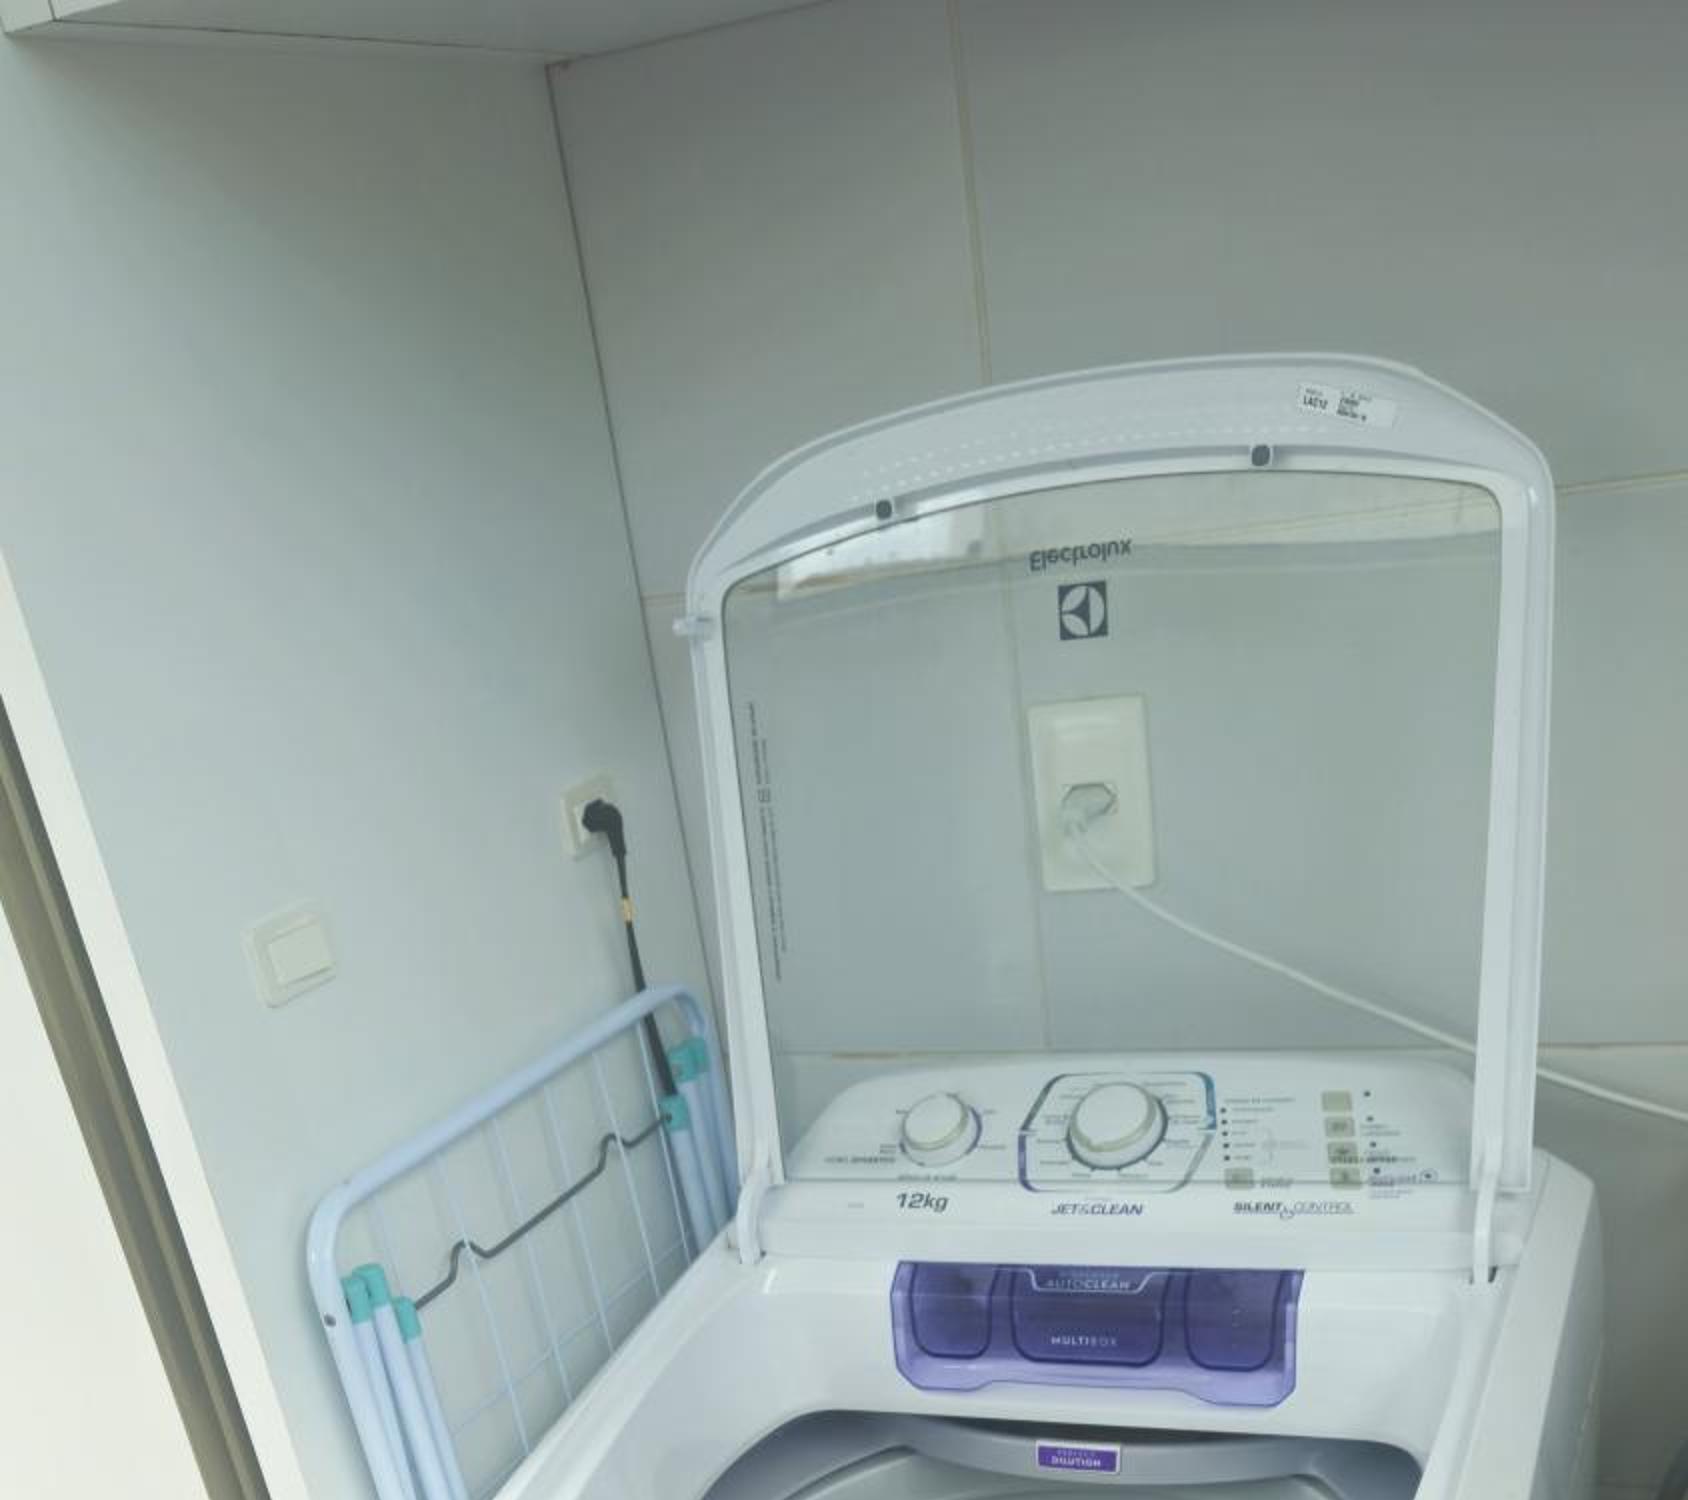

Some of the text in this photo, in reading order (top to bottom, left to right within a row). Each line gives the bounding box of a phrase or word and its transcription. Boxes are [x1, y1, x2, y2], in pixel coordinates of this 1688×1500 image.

[896, 1192, 949, 1213] 12kg
[1234, 1202, 1354, 1215] SILENT CONTROL
[1046, 1279, 1131, 1290] AUTOCLEAN
[1050, 1335, 1118, 1346] MULTIBOX
